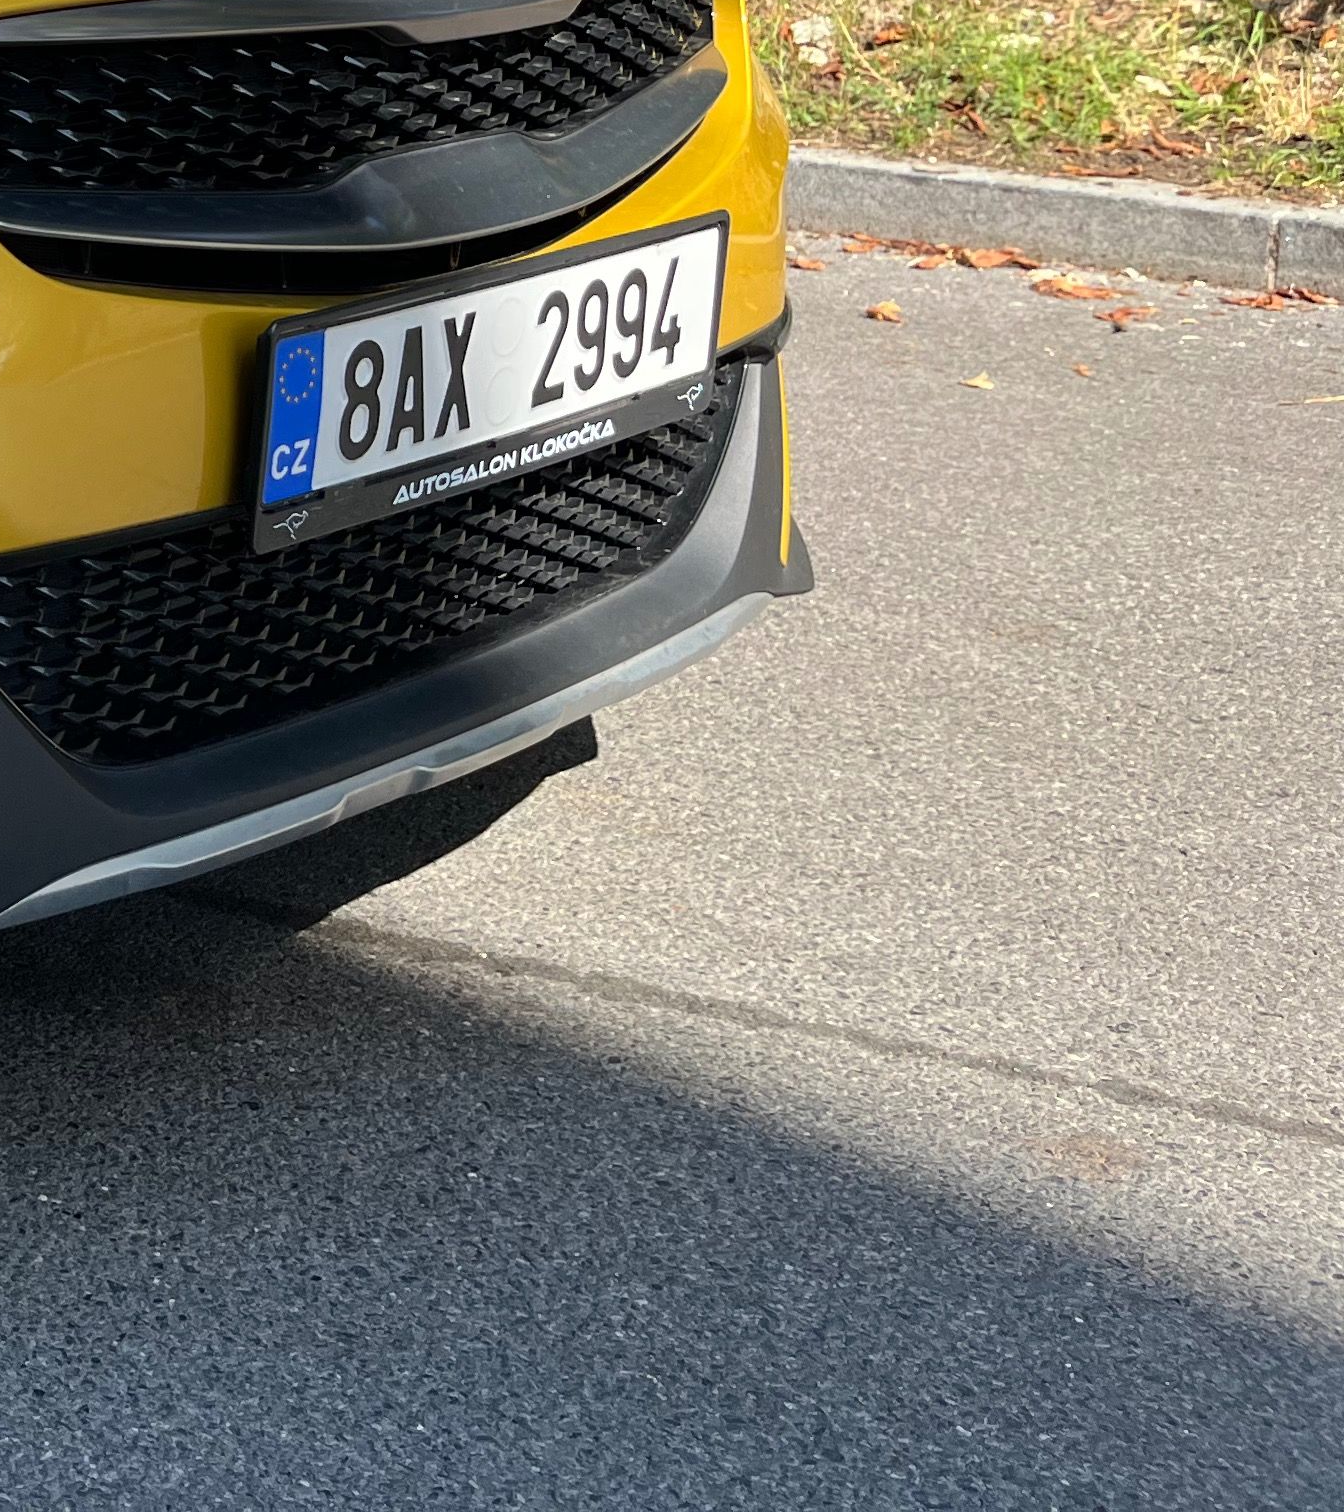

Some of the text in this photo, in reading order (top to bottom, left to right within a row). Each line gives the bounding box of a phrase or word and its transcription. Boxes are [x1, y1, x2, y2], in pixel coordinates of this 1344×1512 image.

[339, 256, 682, 461] 8AX 2994
[271, 438, 311, 480] CZ
[392, 419, 615, 505] AUTOSALON KLOKOČKA
